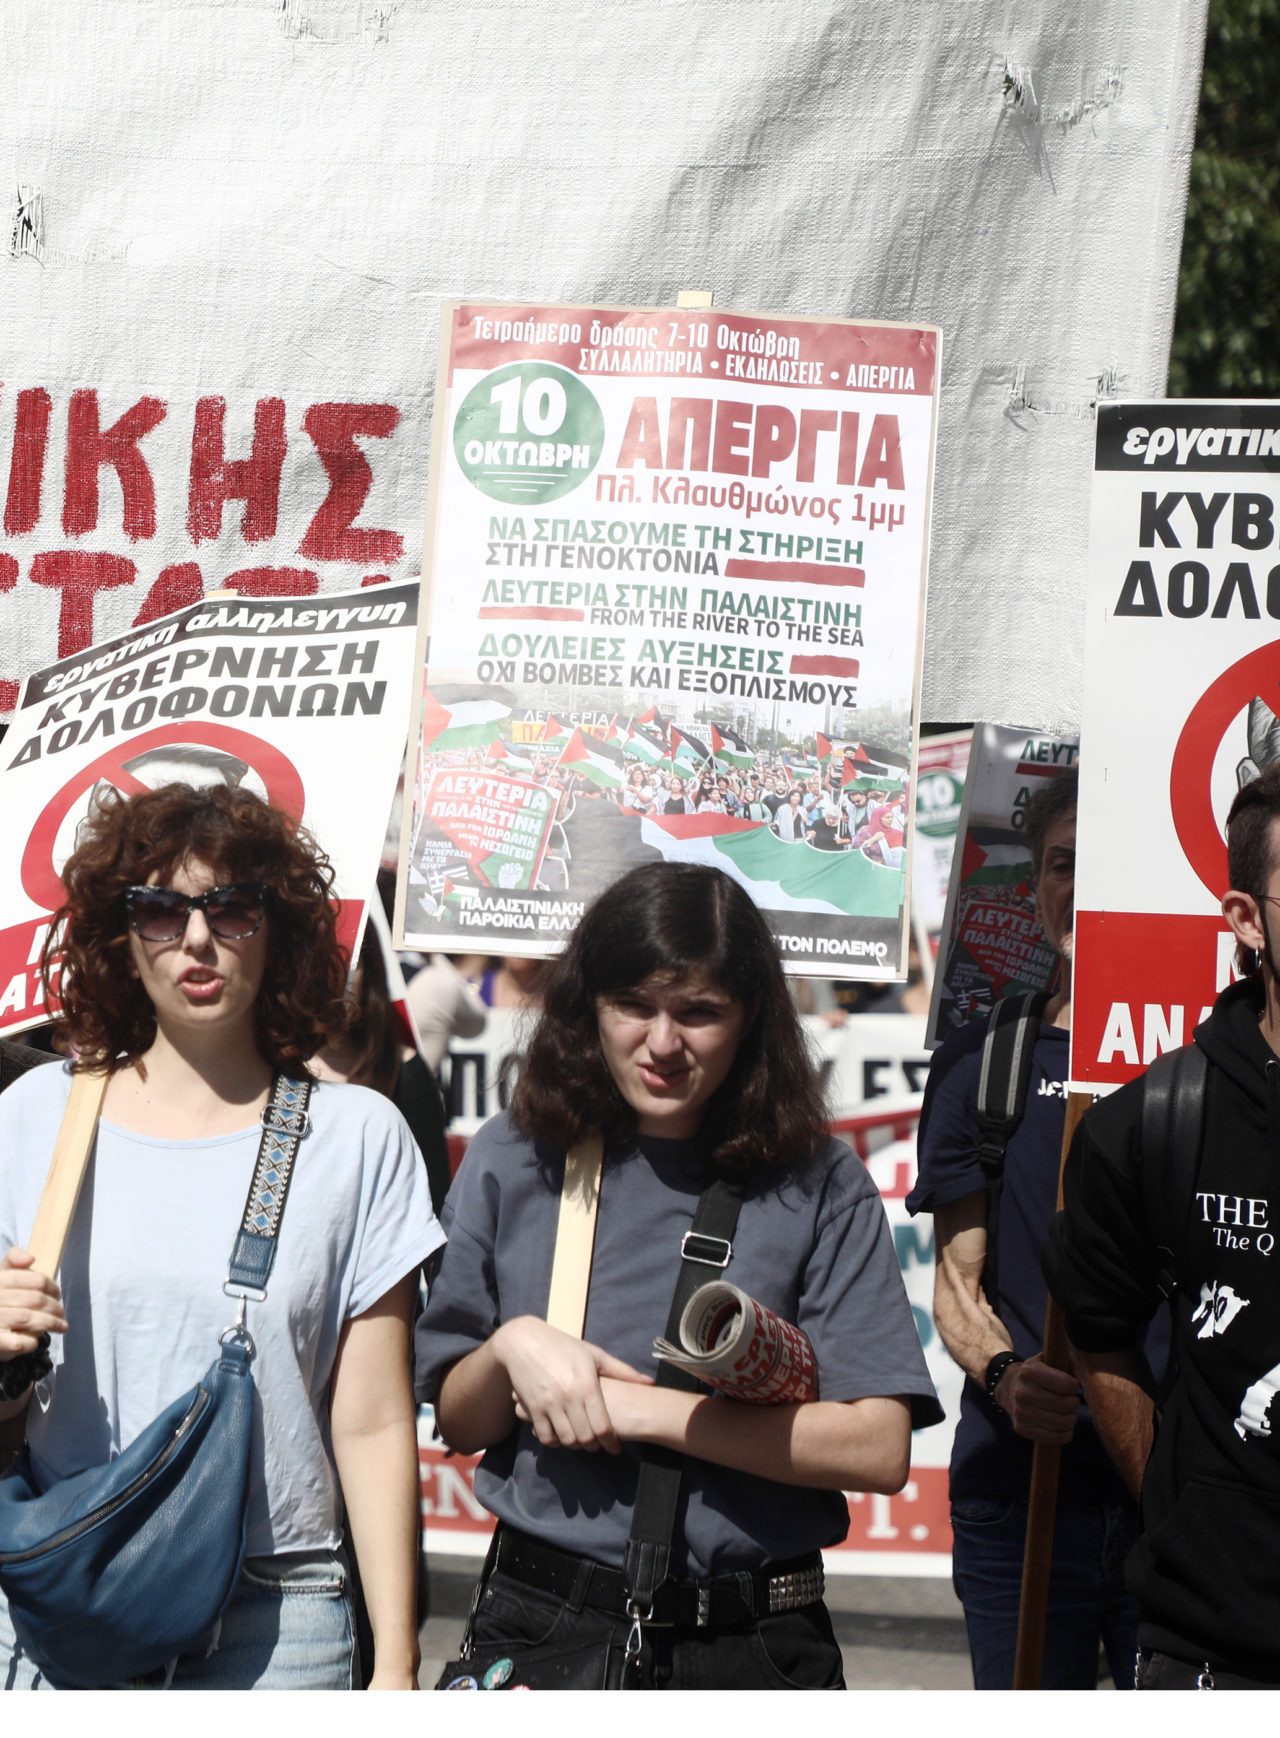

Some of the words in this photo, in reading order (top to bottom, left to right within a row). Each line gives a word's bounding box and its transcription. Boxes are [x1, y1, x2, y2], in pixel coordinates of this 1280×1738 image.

[474, 316, 581, 347] Τετραήμερο
[589, 319, 658, 350] δράσης
[668, 322, 709, 347] 7-10
[717, 324, 800, 359] Οκτώβρη
[579, 349, 703, 374] ΣΥΛΛΑΛΗΤΗΡΙΑ
[725, 355, 824, 385] ΕΚΔΗΛΩΣΕΙΣ
[846, 364, 915, 390] ΑΠΕΡΓΙΑ
[490, 376, 567, 436] 10
[463, 439, 590, 469] ΟΚΤΩΒΡΗ
[616, 396, 905, 490] ΑΠΕΡΓΙΑ
[595, 474, 642, 504] Πλ.
[652, 475, 842, 526] Κλαυθμώνος
[851, 493, 906, 530] 1μμ
[1139, 491, 1280, 550] ΚΥΒ
[489, 516, 527, 541] ΝΑ
[534, 518, 687, 548] ΣΠΑΣΟΥΜΕ
[694, 525, 732, 551] ΤΗ
[738, 531, 864, 564] ΣΤΗΡΙΞΗ
[485, 542, 537, 567] ΣΤΗ
[546, 544, 720, 577] ΓΕΝΟΚΤΟΝΙΑ
[482, 579, 609, 607] ΛΕΥΤΕΡΙΑ
[615, 584, 687, 610] ΣΤΗΝ
[701, 588, 862, 628] ΠΑΛΑΙΣΤΙΝΗ
[590, 607, 647, 628] FROM
[651, 610, 687, 630] THE
[693, 612, 750, 636] RIVER
[754, 618, 781, 638] TO
[785, 621, 822, 643] THE
[827, 627, 864, 647] SEA
[478, 633, 626, 662] ΔΟΥΛΕΙΕΣ
[638, 639, 784, 675] ΑΥΞΗΣΕΙΣ
[37, 640, 380, 731] ΚΥΒΕΡΝΗΣΗ
[477, 660, 516, 683] ΟΧΙ
[522, 662, 624, 687] ΒΟΜΒΕΣ
[630, 666, 670, 689] ΚΑΙ
[678, 669, 858, 708] ΕΞΟΠΛΙΣΜΟΥΣ
[6, 680, 387, 771] ΔΟΛΟΦΟΝΩΝ
[438, 775, 548, 811] ΛΕΥΤΕΡΙΑ
[431, 801, 543, 836] ΠΑΛΑΙΣΤΙΝΗ
[482, 825, 537, 849] ΙΟΡΔΑΝΗ
[479, 840, 534, 861] ΜΕΣΟΓΕΙΟ
[458, 911, 535, 930] ΠΑΡΟΙΚΙΑ
[459, 897, 585, 916] ΠΑΛΑΙΣΤΙΝΙΑΚΗ
[970, 906, 1048, 944] ΛΕΥΤΕΡ
[780, 935, 813, 953] ΤΟΝ
[816, 937, 889, 959] ΠΟΛΕΜΟ
[963, 930, 1056, 967] ΠΑΛΑΙΣΤΙΝΗ
[1006, 955, 1051, 979] ΙΟΡΔΑΝΗ
[1196, 1192, 1269, 1229] THE
[1212, 1227, 1250, 1250] The
